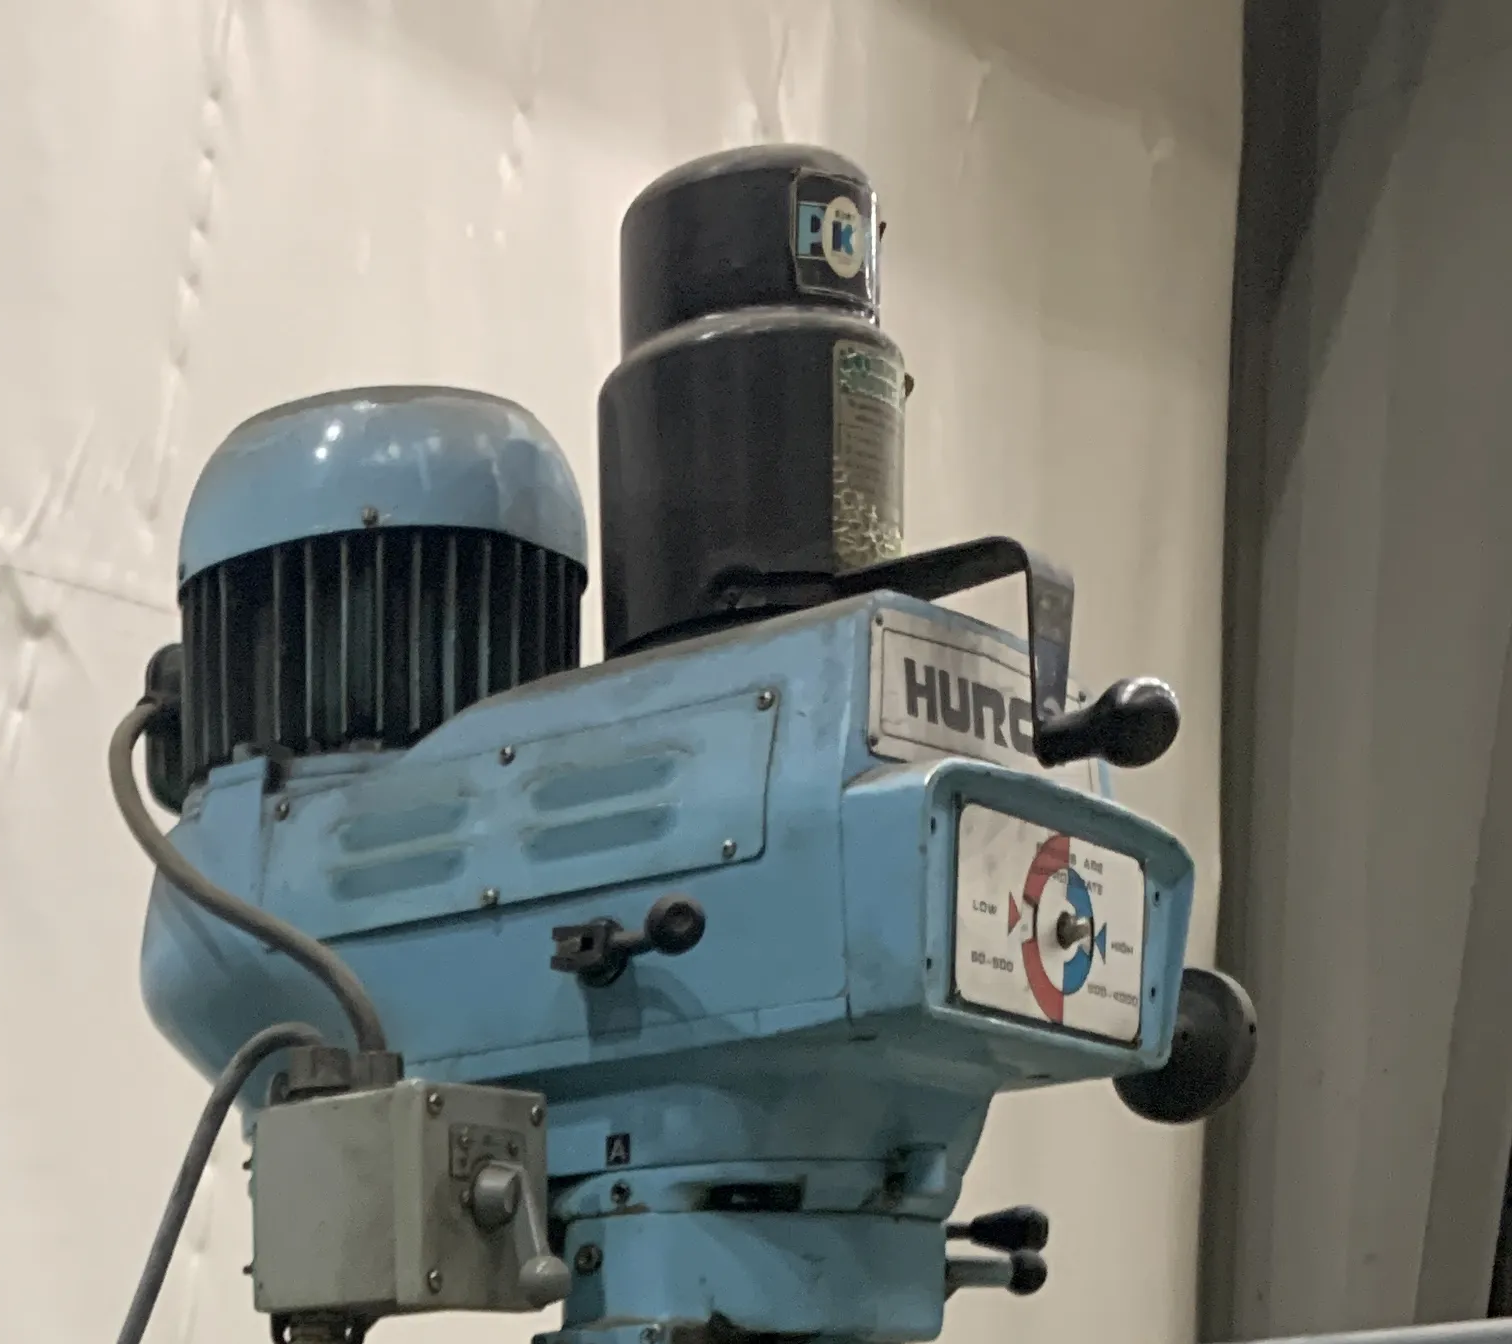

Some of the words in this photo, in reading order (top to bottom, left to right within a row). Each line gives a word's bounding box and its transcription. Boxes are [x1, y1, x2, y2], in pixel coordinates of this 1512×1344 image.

[903, 656, 1036, 757] HURC
[971, 898, 998, 916] LOW
[609, 1139, 626, 1161] A
